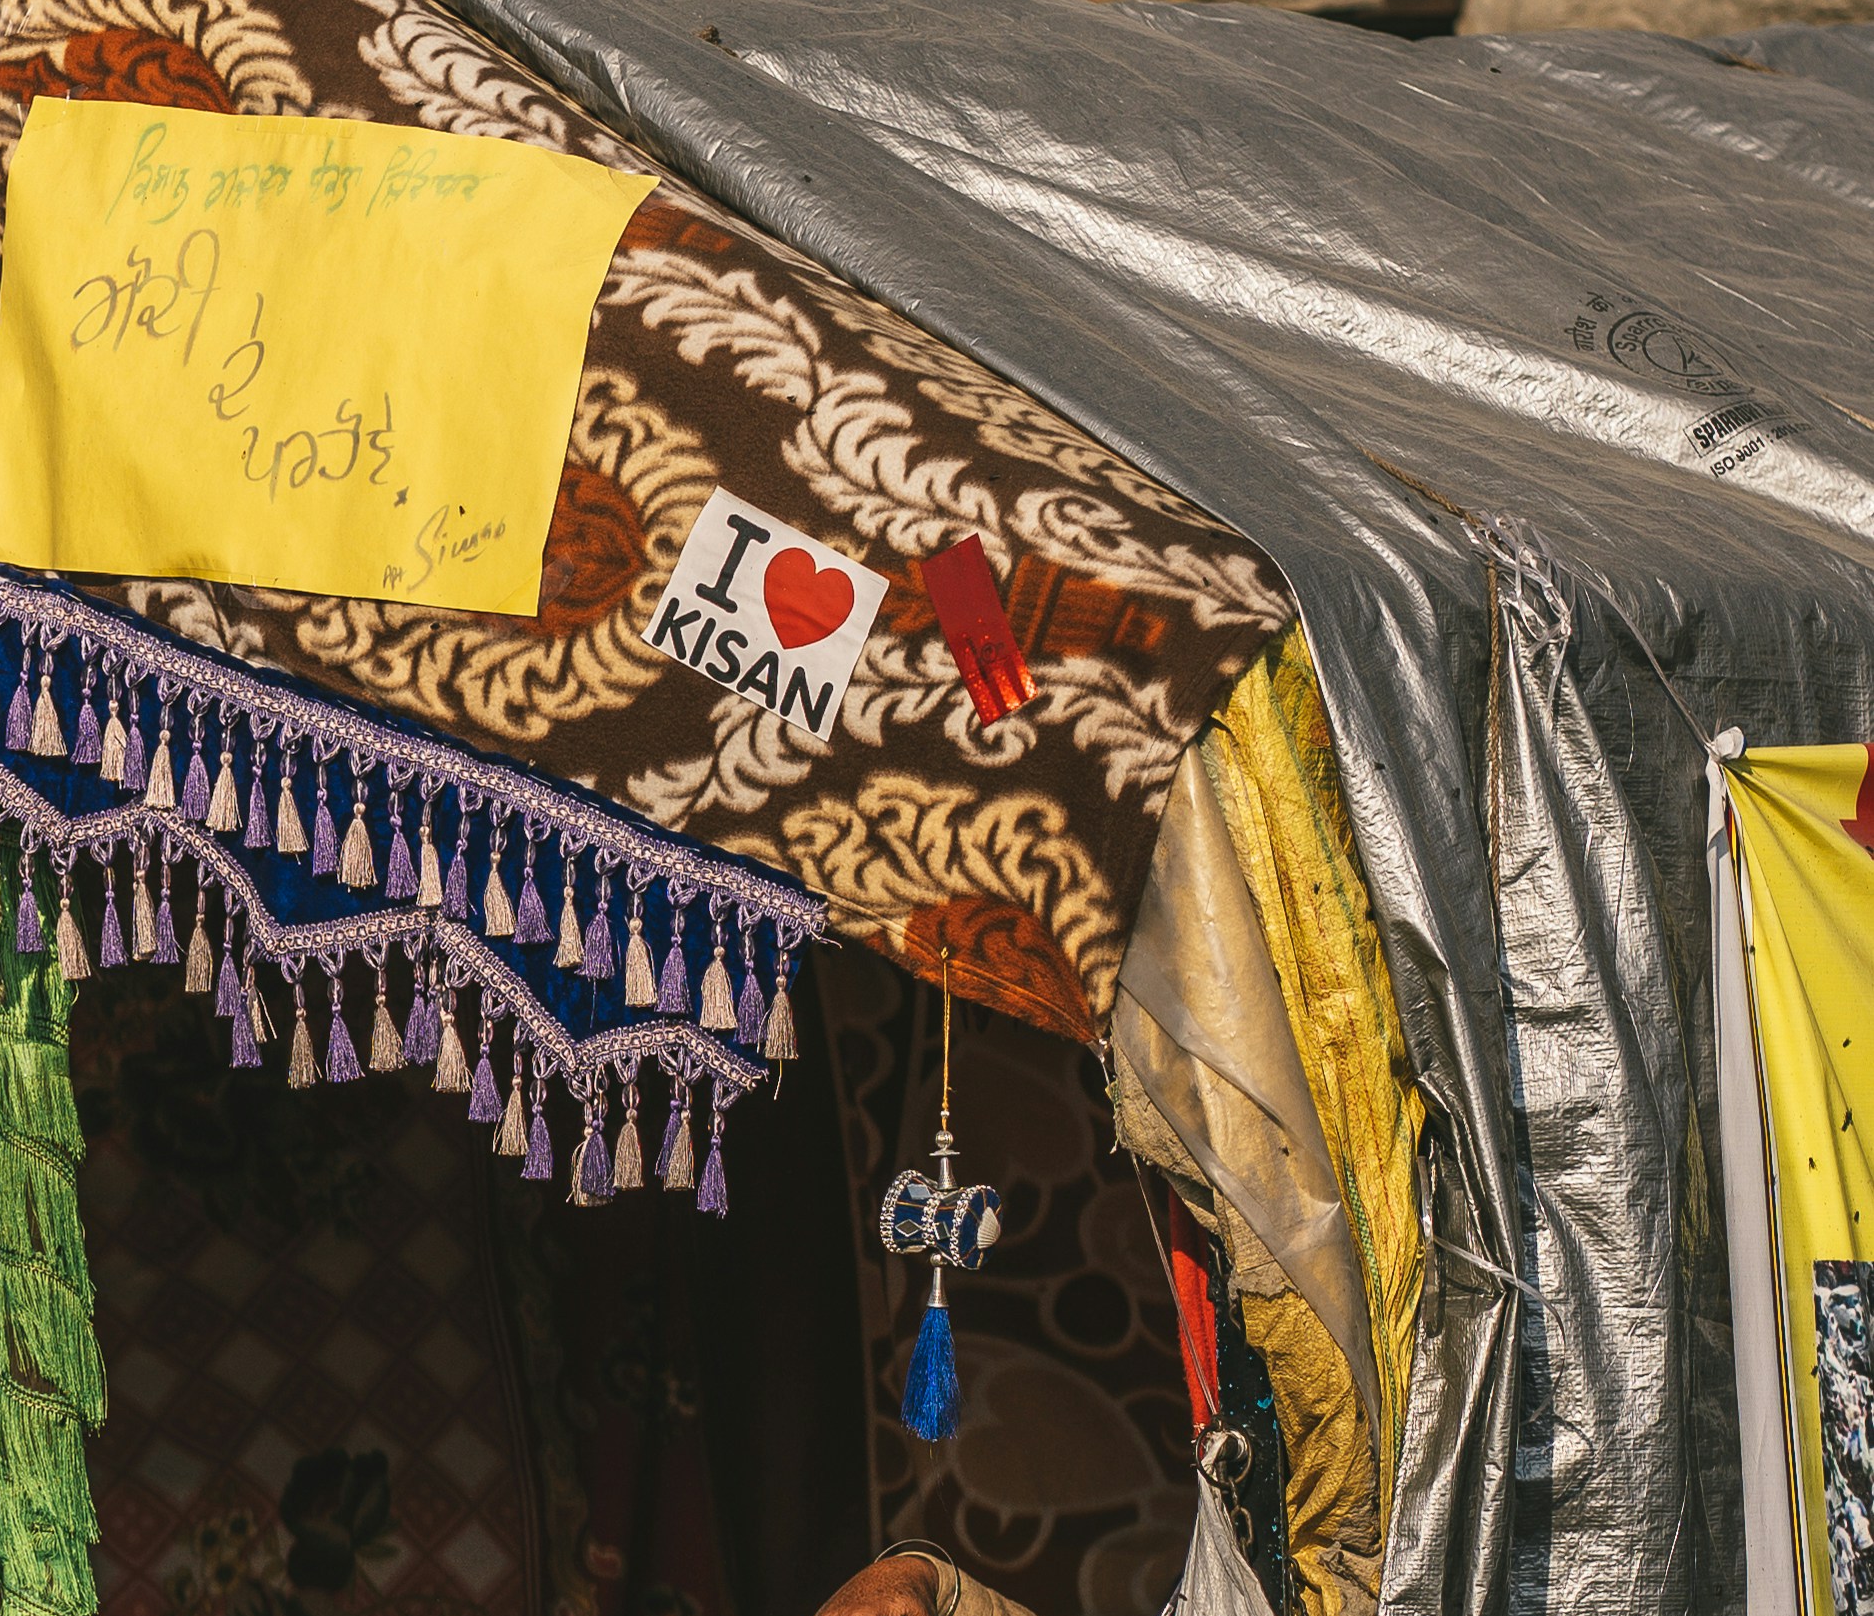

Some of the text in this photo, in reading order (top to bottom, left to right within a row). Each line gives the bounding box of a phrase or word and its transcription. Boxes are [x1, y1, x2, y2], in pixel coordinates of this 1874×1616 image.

[1709, 457, 1735, 478] ISO
[1735, 436, 1766, 462] 9001
[695, 514, 771, 613] I
[651, 597, 834, 733] KISAN
